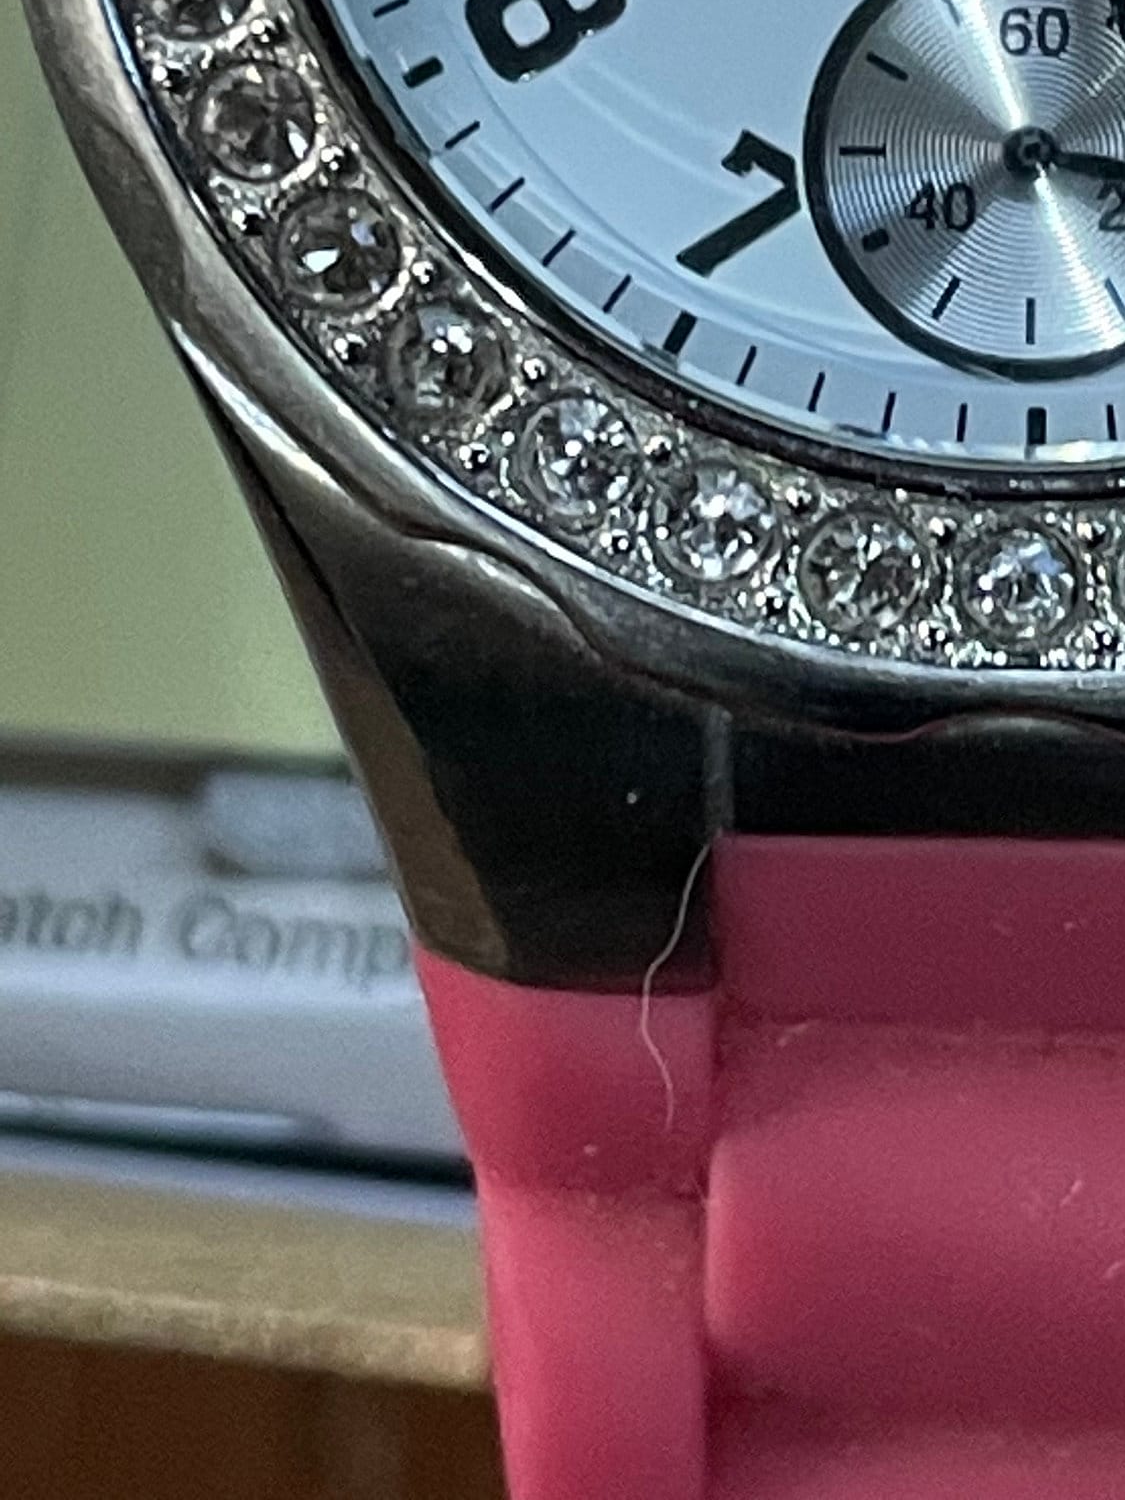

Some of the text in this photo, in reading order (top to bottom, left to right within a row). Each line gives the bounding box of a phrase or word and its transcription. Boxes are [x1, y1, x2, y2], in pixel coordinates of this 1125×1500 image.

[1000, 7, 1070, 58] 60
[676, 129, 801, 278] 7
[905, 182, 976, 234] 40
